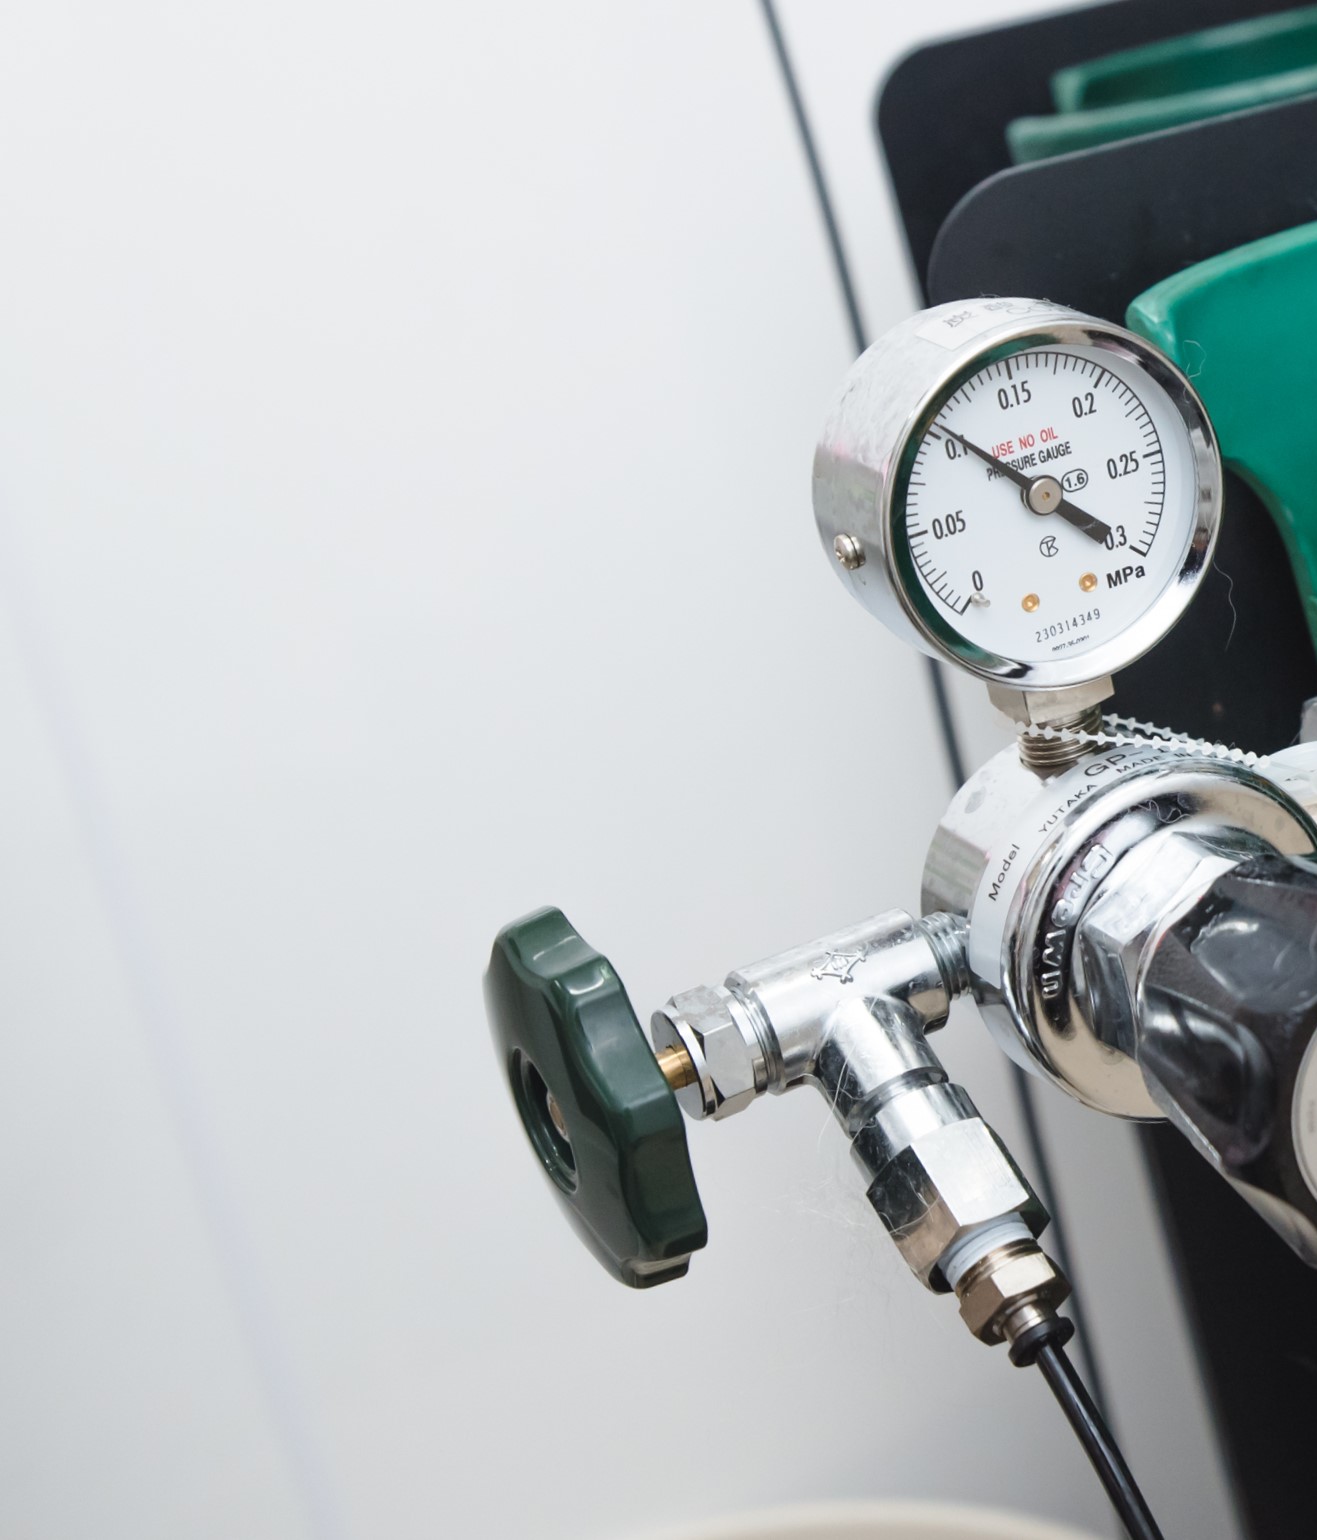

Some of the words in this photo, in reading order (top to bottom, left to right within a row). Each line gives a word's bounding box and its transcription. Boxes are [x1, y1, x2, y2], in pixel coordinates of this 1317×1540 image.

[997, 381, 1032, 410] 0.15
[1072, 392, 1097, 419] 0.2
[945, 434, 968, 460] 0.1
[992, 441, 1015, 459] USE
[1019, 434, 1035, 450] NO
[1040, 427, 1058, 443] OIL
[986, 453, 1038, 481] PRSURE
[1038, 441, 1072, 463] GAUGE
[1107, 451, 1140, 480] 0.25
[1065, 473, 1086, 488] 1.6
[932, 511, 966, 540] 0.05
[1104, 525, 1127, 551] 0.3
[972, 571, 984, 592] 0
[1106, 565, 1146, 589] MPa
[1035, 608, 1101, 643] 230314349
[988, 843, 1020, 901] Model
[1038, 784, 1097, 832] YUTAKA
[1116, 755, 1163, 774] MADE
